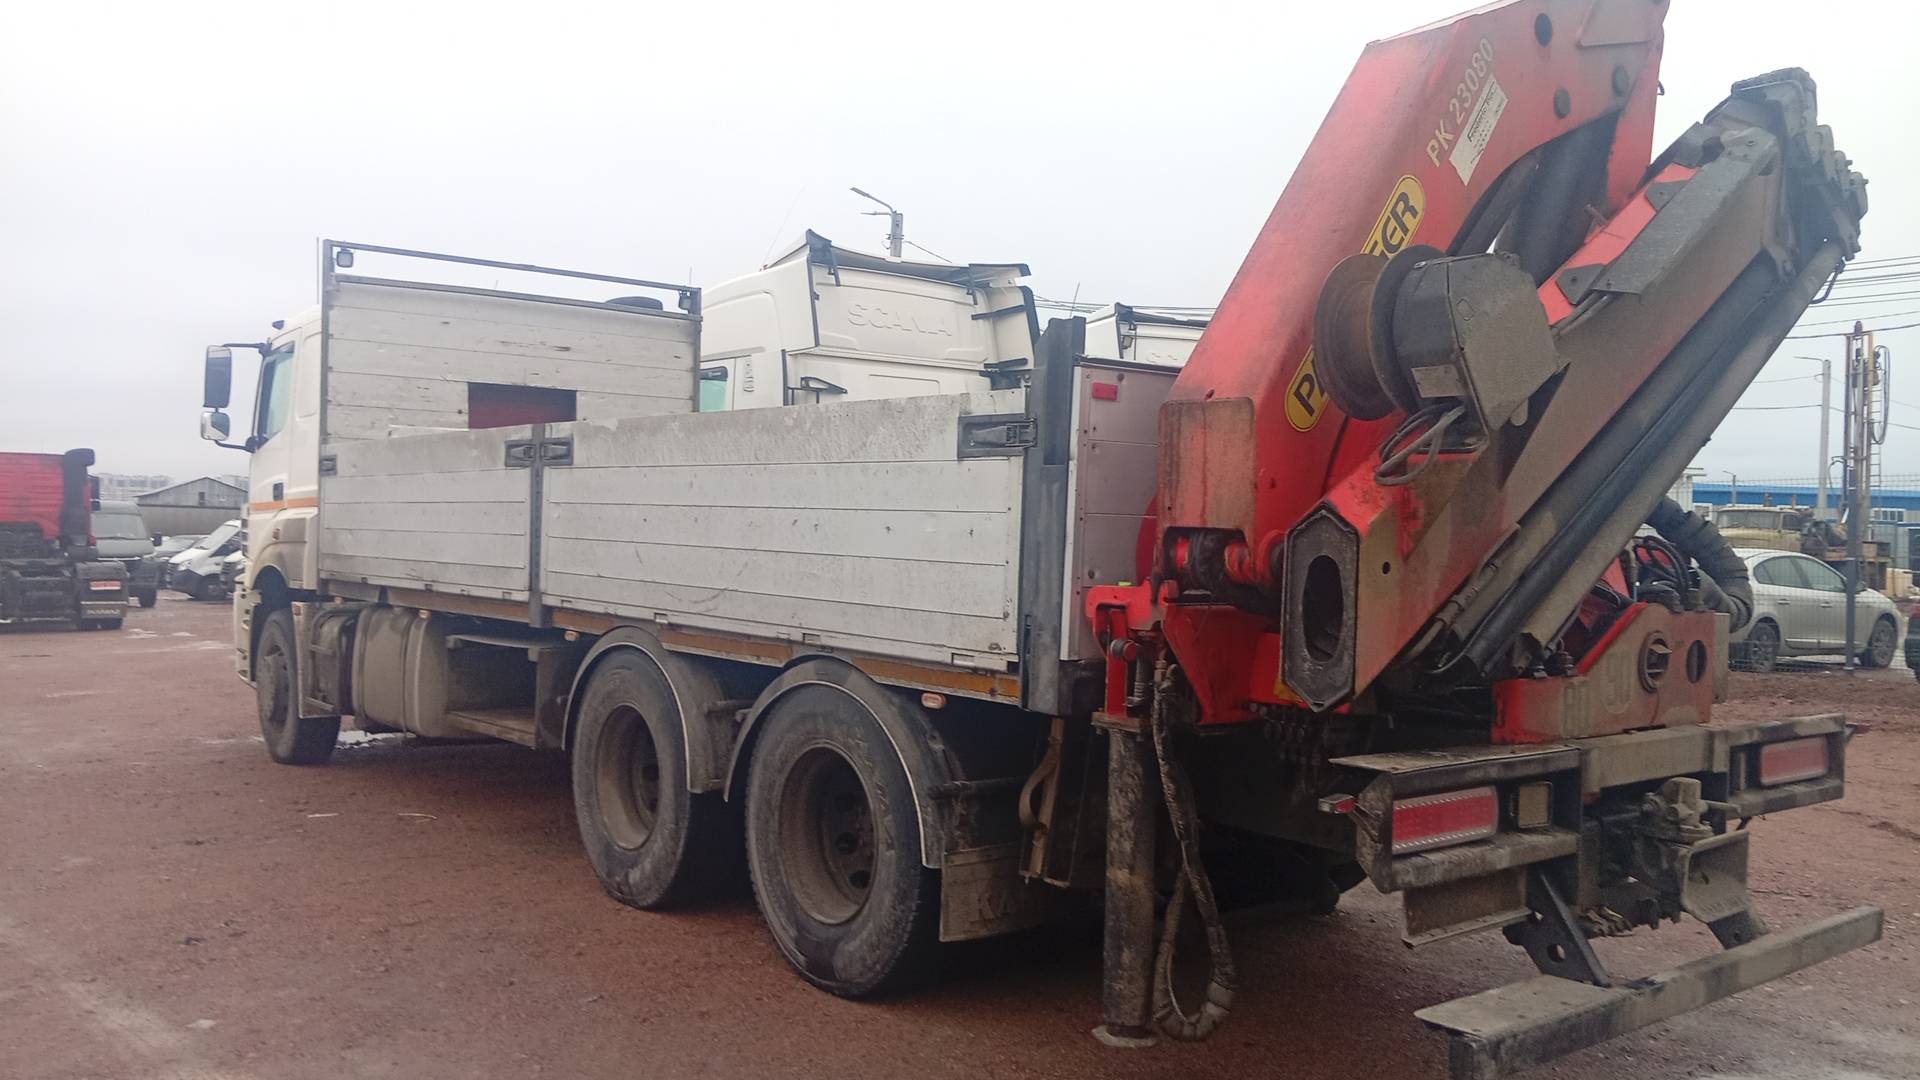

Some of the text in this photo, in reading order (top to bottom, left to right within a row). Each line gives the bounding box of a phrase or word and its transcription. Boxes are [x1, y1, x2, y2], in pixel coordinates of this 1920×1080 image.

[1426, 120, 1454, 167] PK
[1450, 38, 1493, 125] 23080
[847, 303, 953, 336] SCANIA
